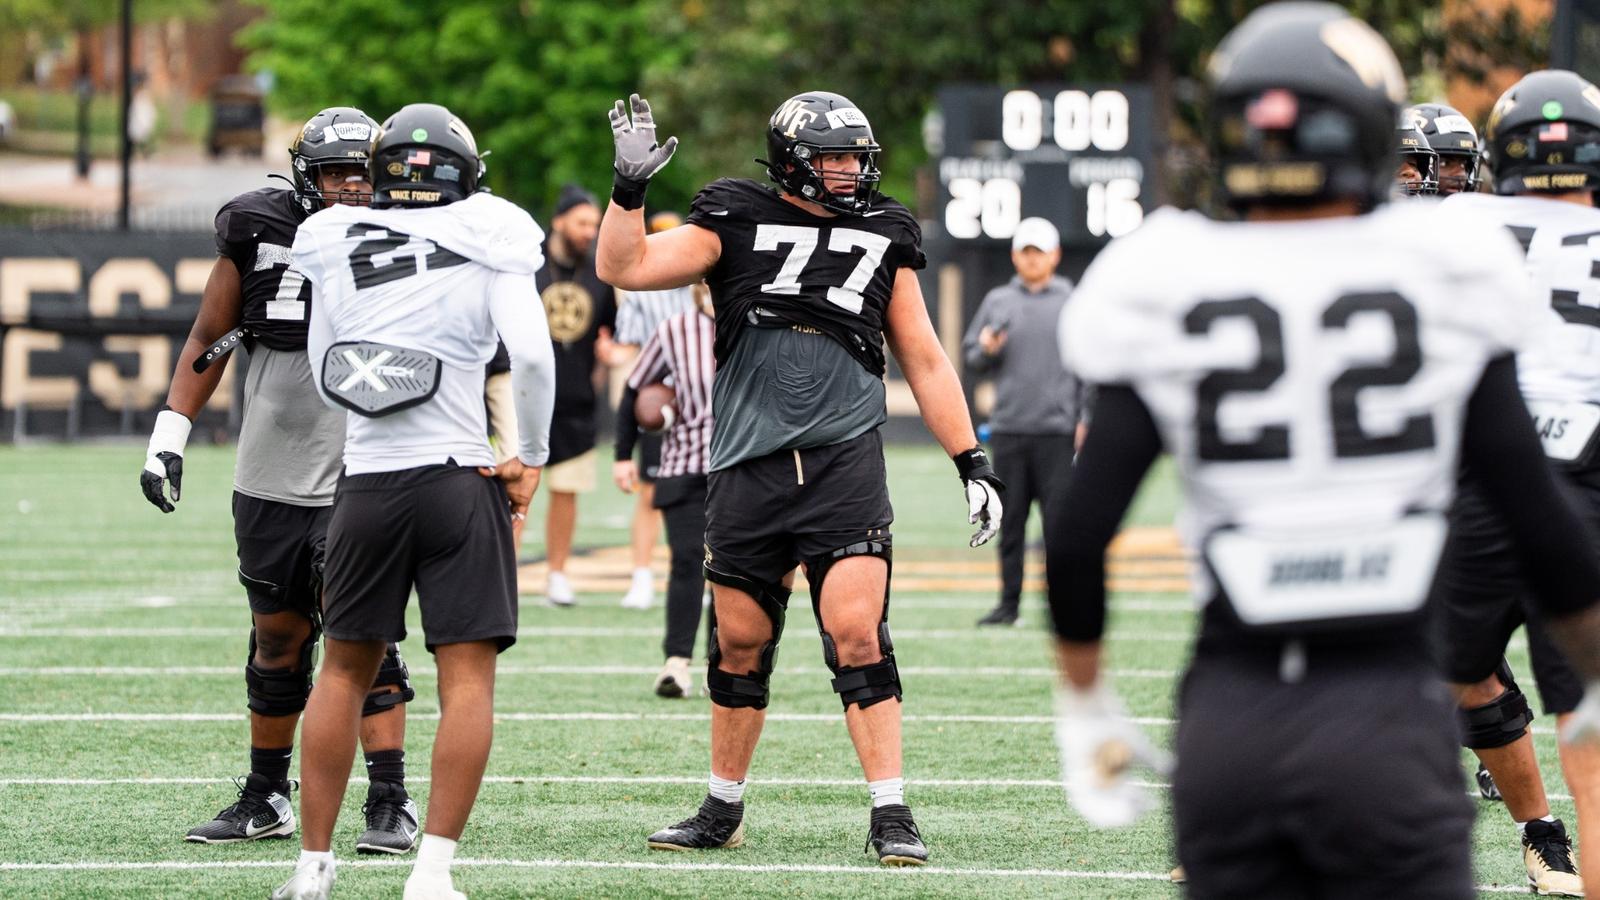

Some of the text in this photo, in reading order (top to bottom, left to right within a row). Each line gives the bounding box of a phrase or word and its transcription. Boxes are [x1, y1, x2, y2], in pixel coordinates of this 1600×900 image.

[389, 190, 441, 201] WAKE FOREST
[411, 173, 422, 182] 21
[1523, 174, 1588, 189] WAKE FOREST
[946, 178, 1021, 239] 20
[753, 224, 891, 315] 77
[1183, 291, 1436, 461] 22
